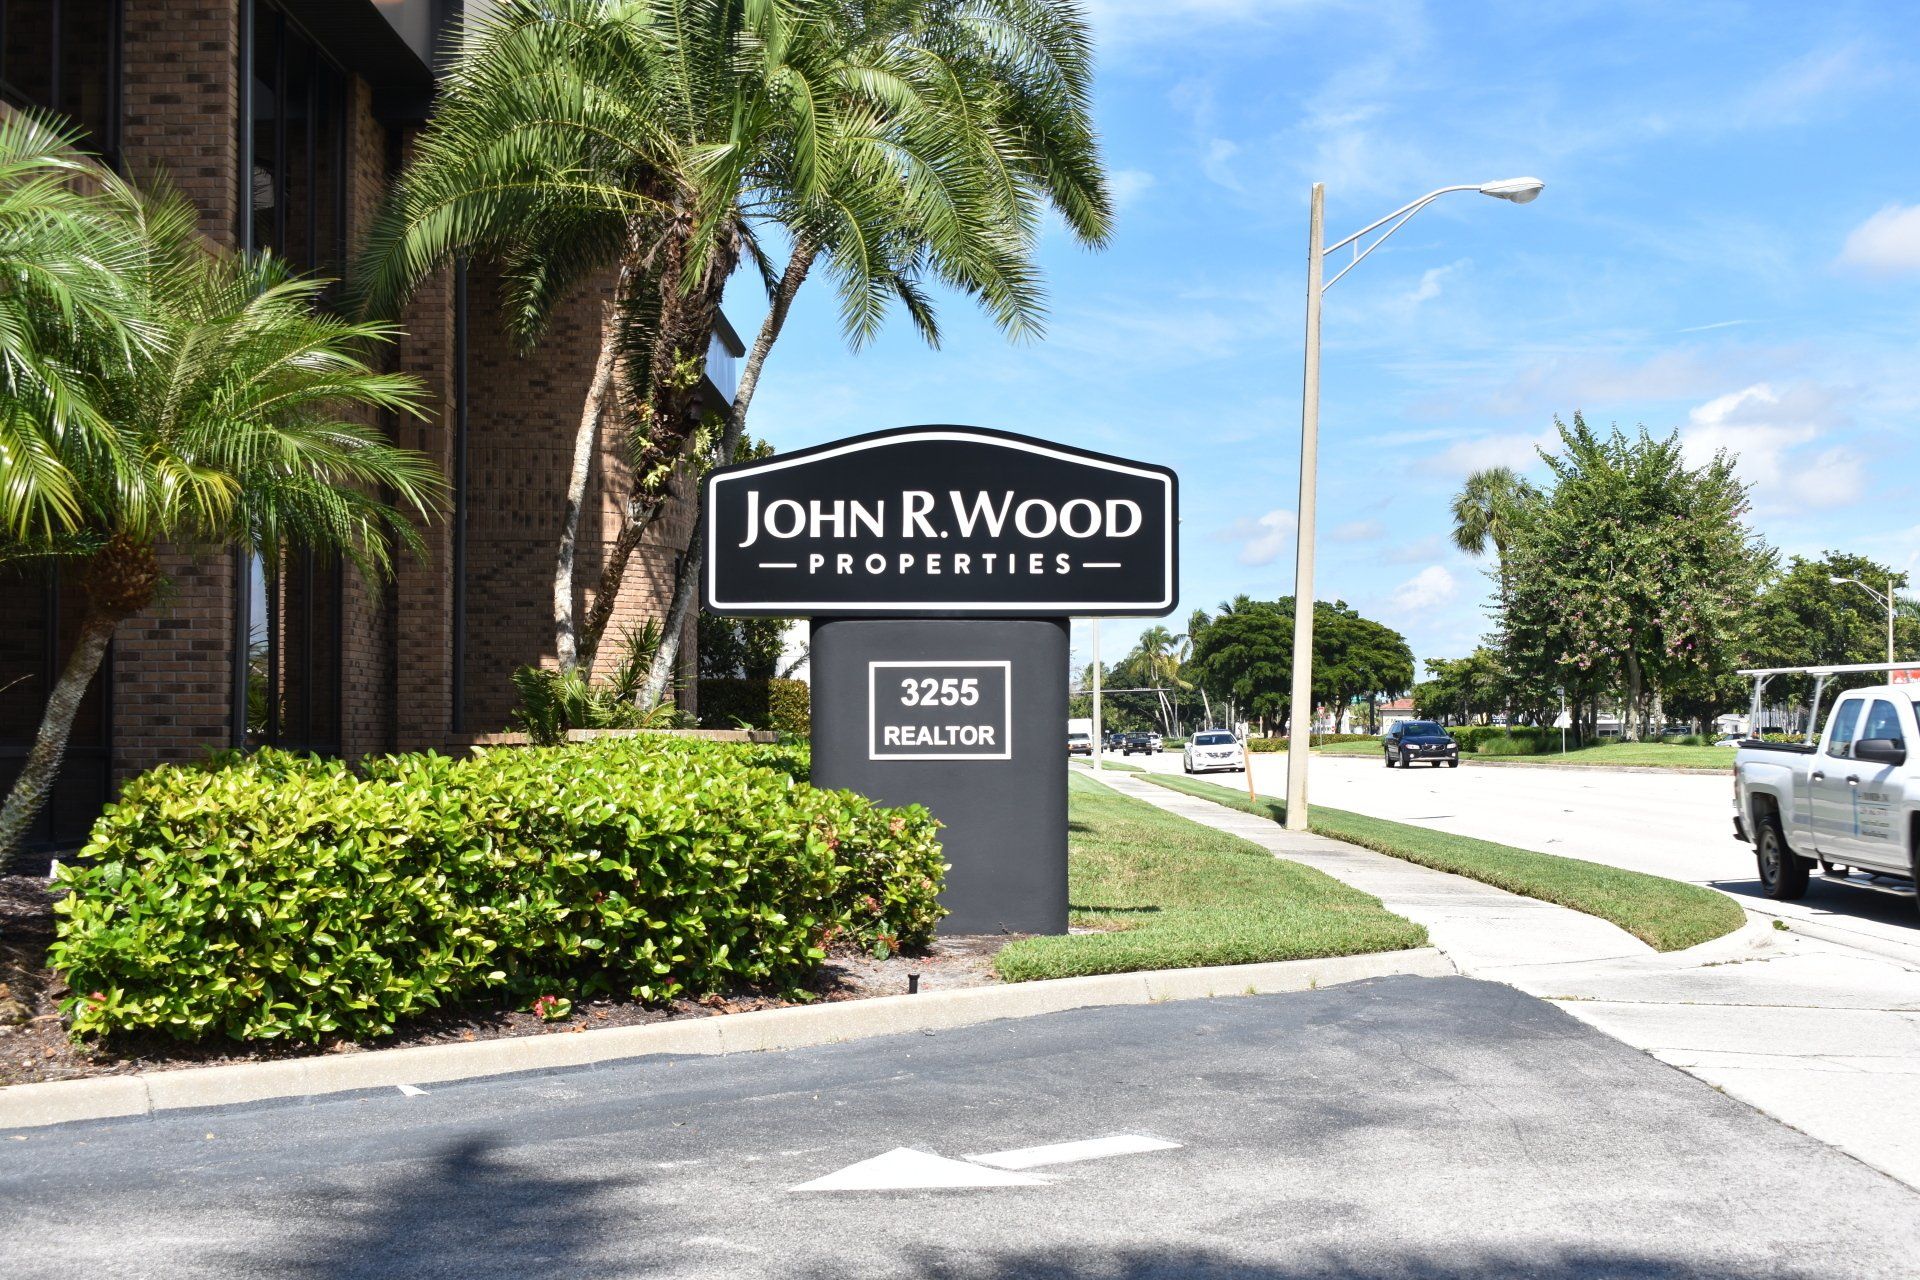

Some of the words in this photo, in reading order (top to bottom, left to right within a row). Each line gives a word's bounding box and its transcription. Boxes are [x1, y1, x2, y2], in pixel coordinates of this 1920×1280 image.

[738, 490, 885, 548] JOHN
[809, 553, 1071, 575] PROPERTIES
[900, 677, 980, 707] 3255
[883, 725, 996, 746] REALTOR
